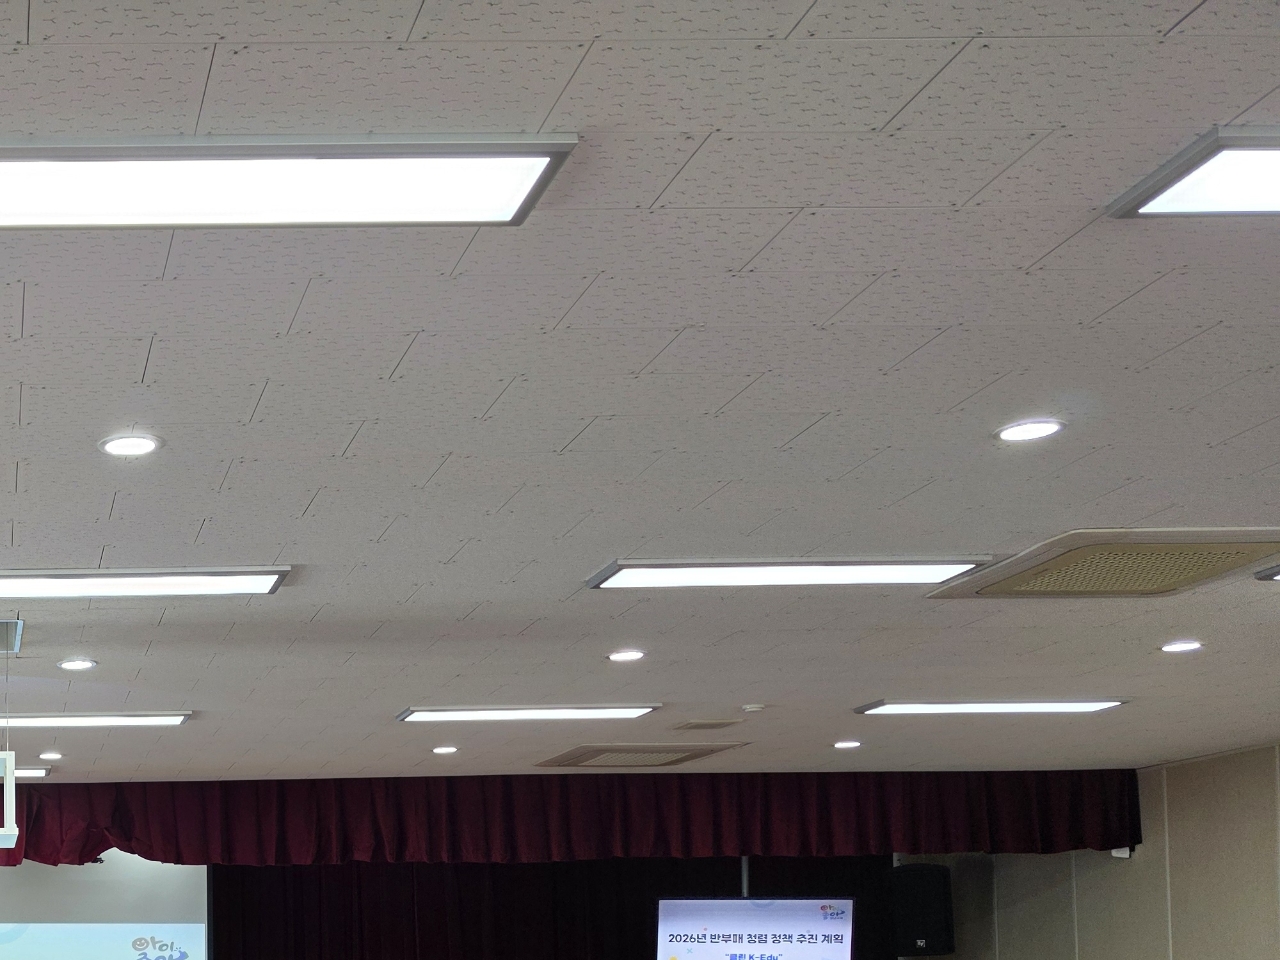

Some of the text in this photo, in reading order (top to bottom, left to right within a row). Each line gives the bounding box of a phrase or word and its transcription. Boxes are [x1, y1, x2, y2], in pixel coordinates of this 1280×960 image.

[131, 936, 175, 952] 아이
[668, 933, 707, 944] 2026년
[746, 933, 768, 944] 청렴
[771, 933, 793, 944] 정책
[796, 933, 818, 944] 추진
[821, 933, 844, 944] 계획
